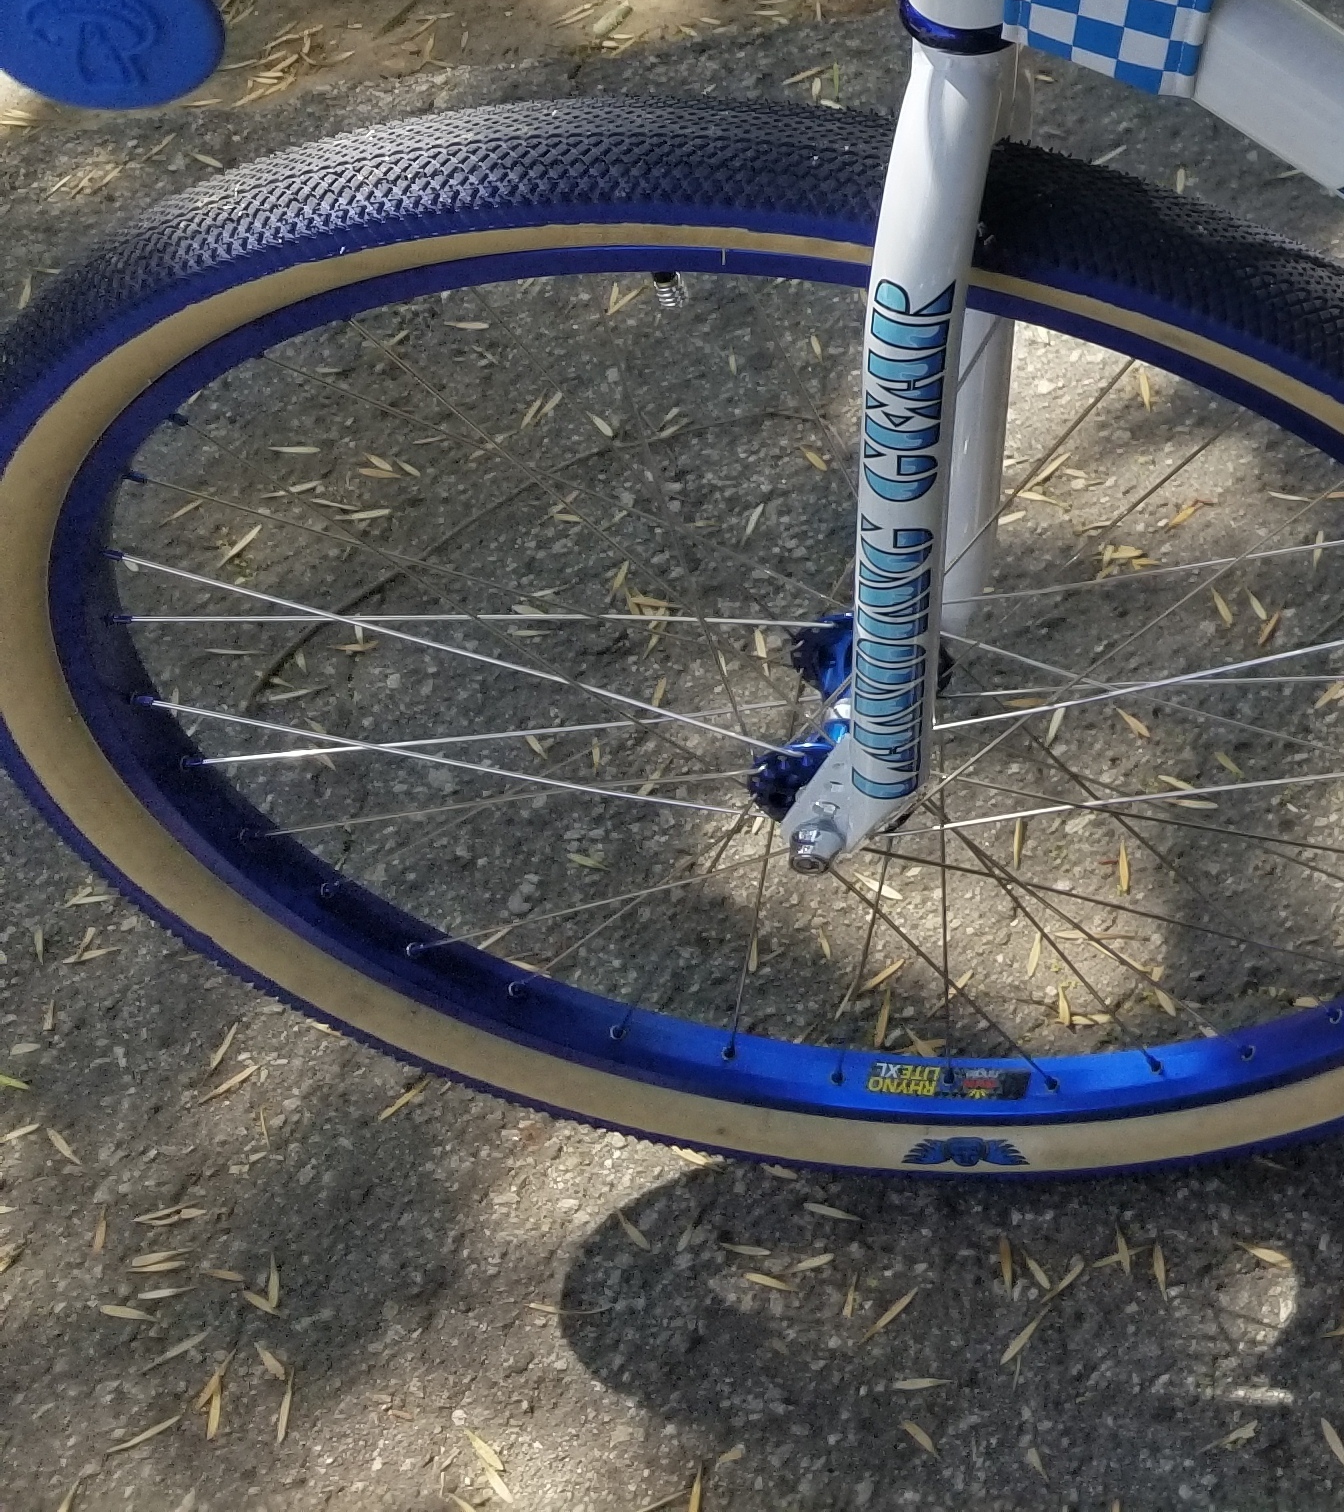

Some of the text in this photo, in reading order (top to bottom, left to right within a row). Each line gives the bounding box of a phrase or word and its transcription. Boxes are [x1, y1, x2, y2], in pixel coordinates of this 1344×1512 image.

[851, 279, 956, 799] LANDING GEAR
[868, 1076, 937, 1096] RHYNO
